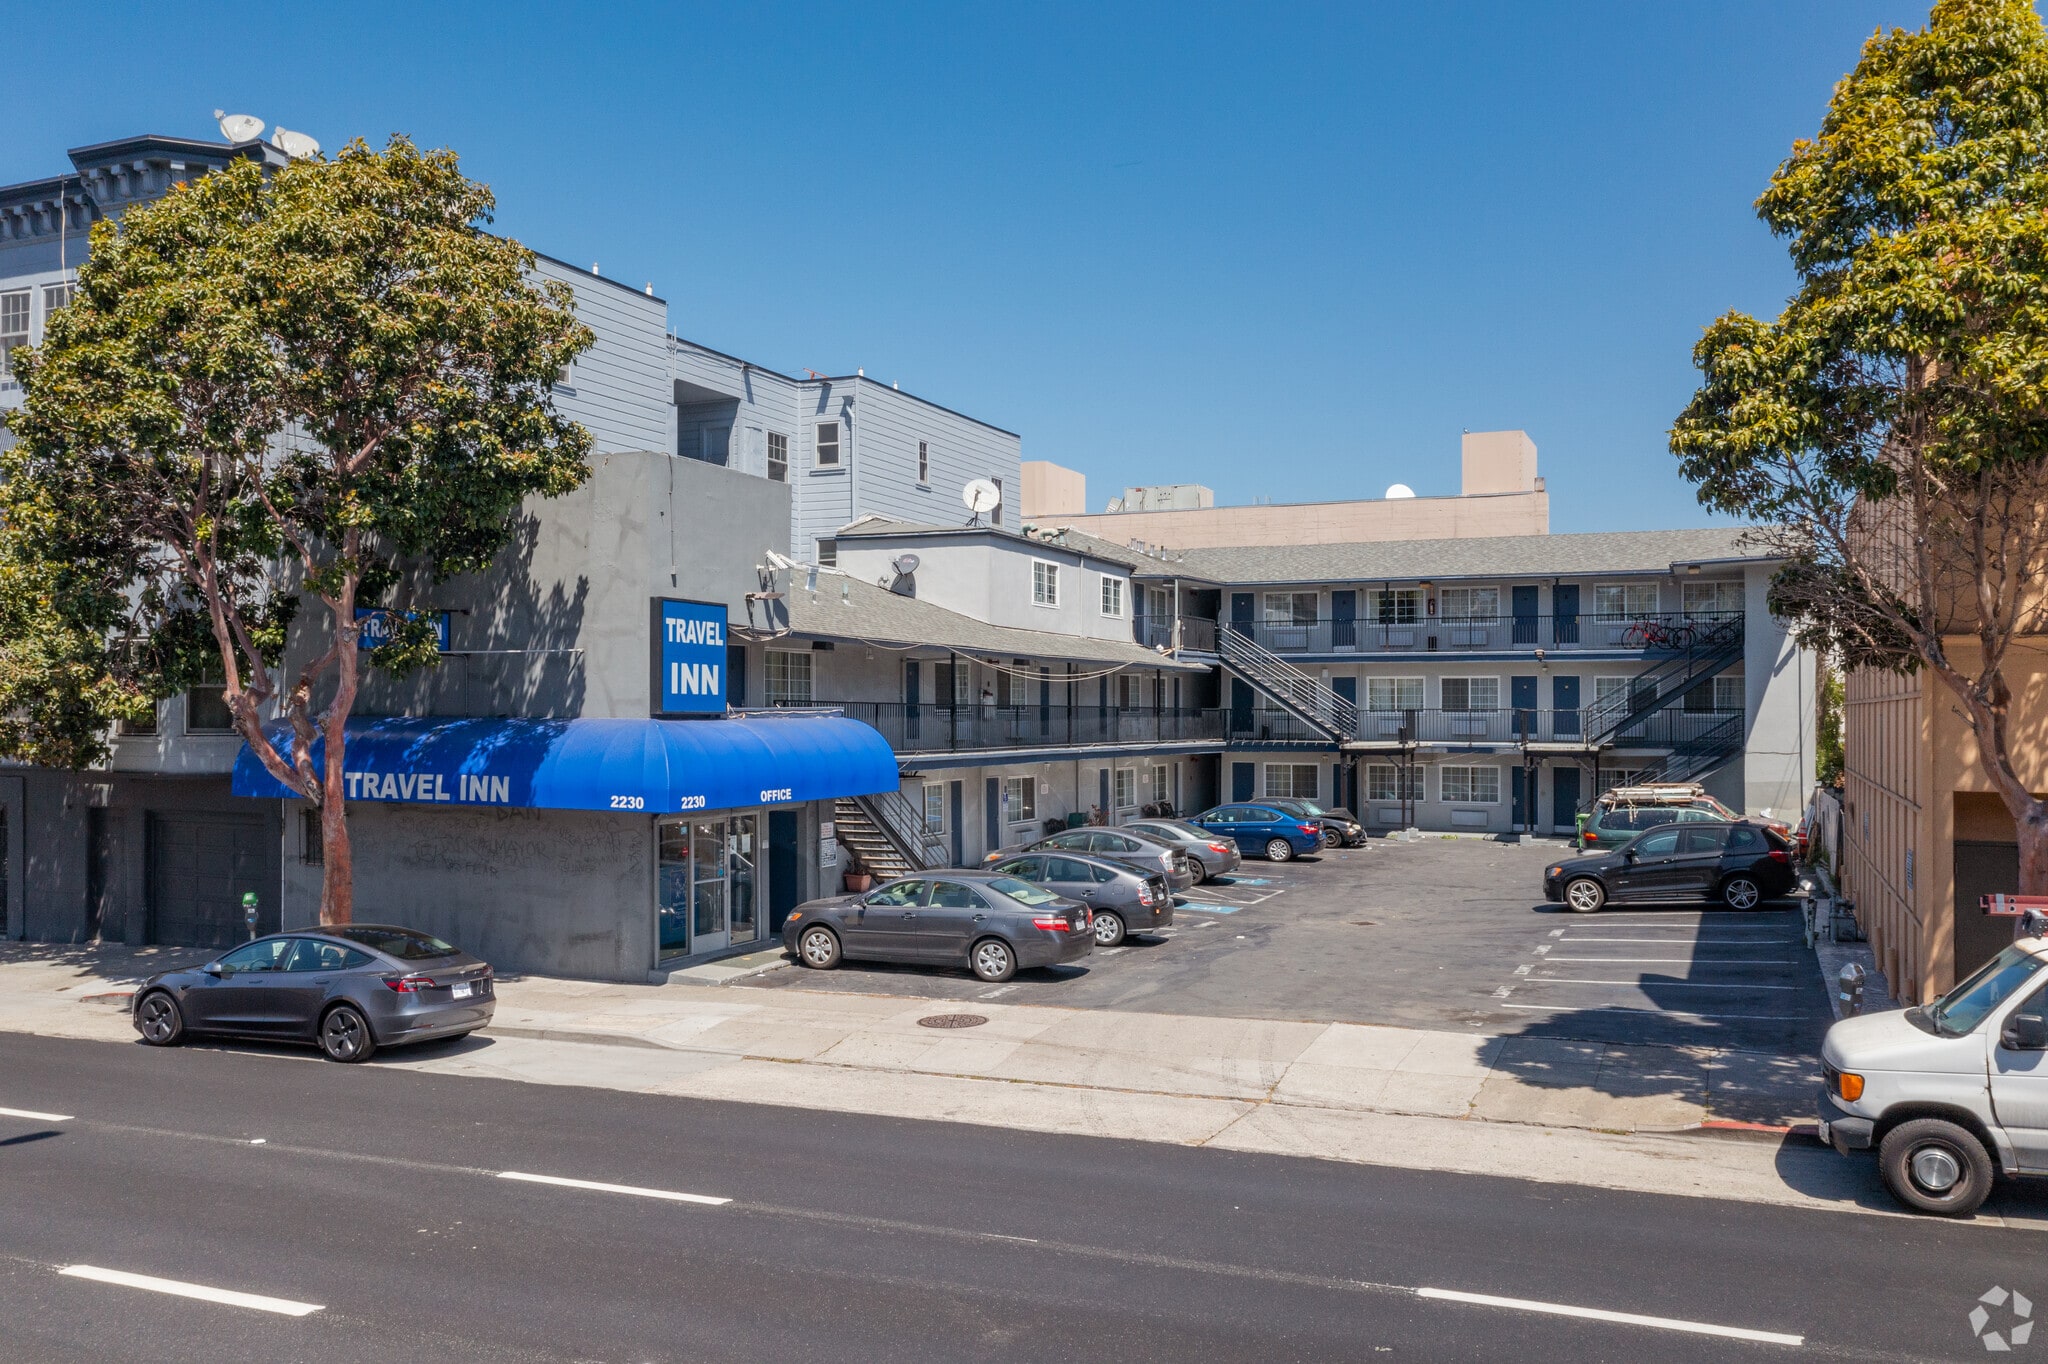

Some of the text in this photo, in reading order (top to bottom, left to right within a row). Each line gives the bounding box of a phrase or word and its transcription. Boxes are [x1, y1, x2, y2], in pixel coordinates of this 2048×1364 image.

[665, 617, 724, 646] TRAVEL
[671, 662, 719, 696] INN
[345, 771, 510, 803] TRAVEL INN
[760, 788, 792, 802] OFFICE
[610, 795, 645, 810] 2230
[681, 795, 706, 810] 2230
